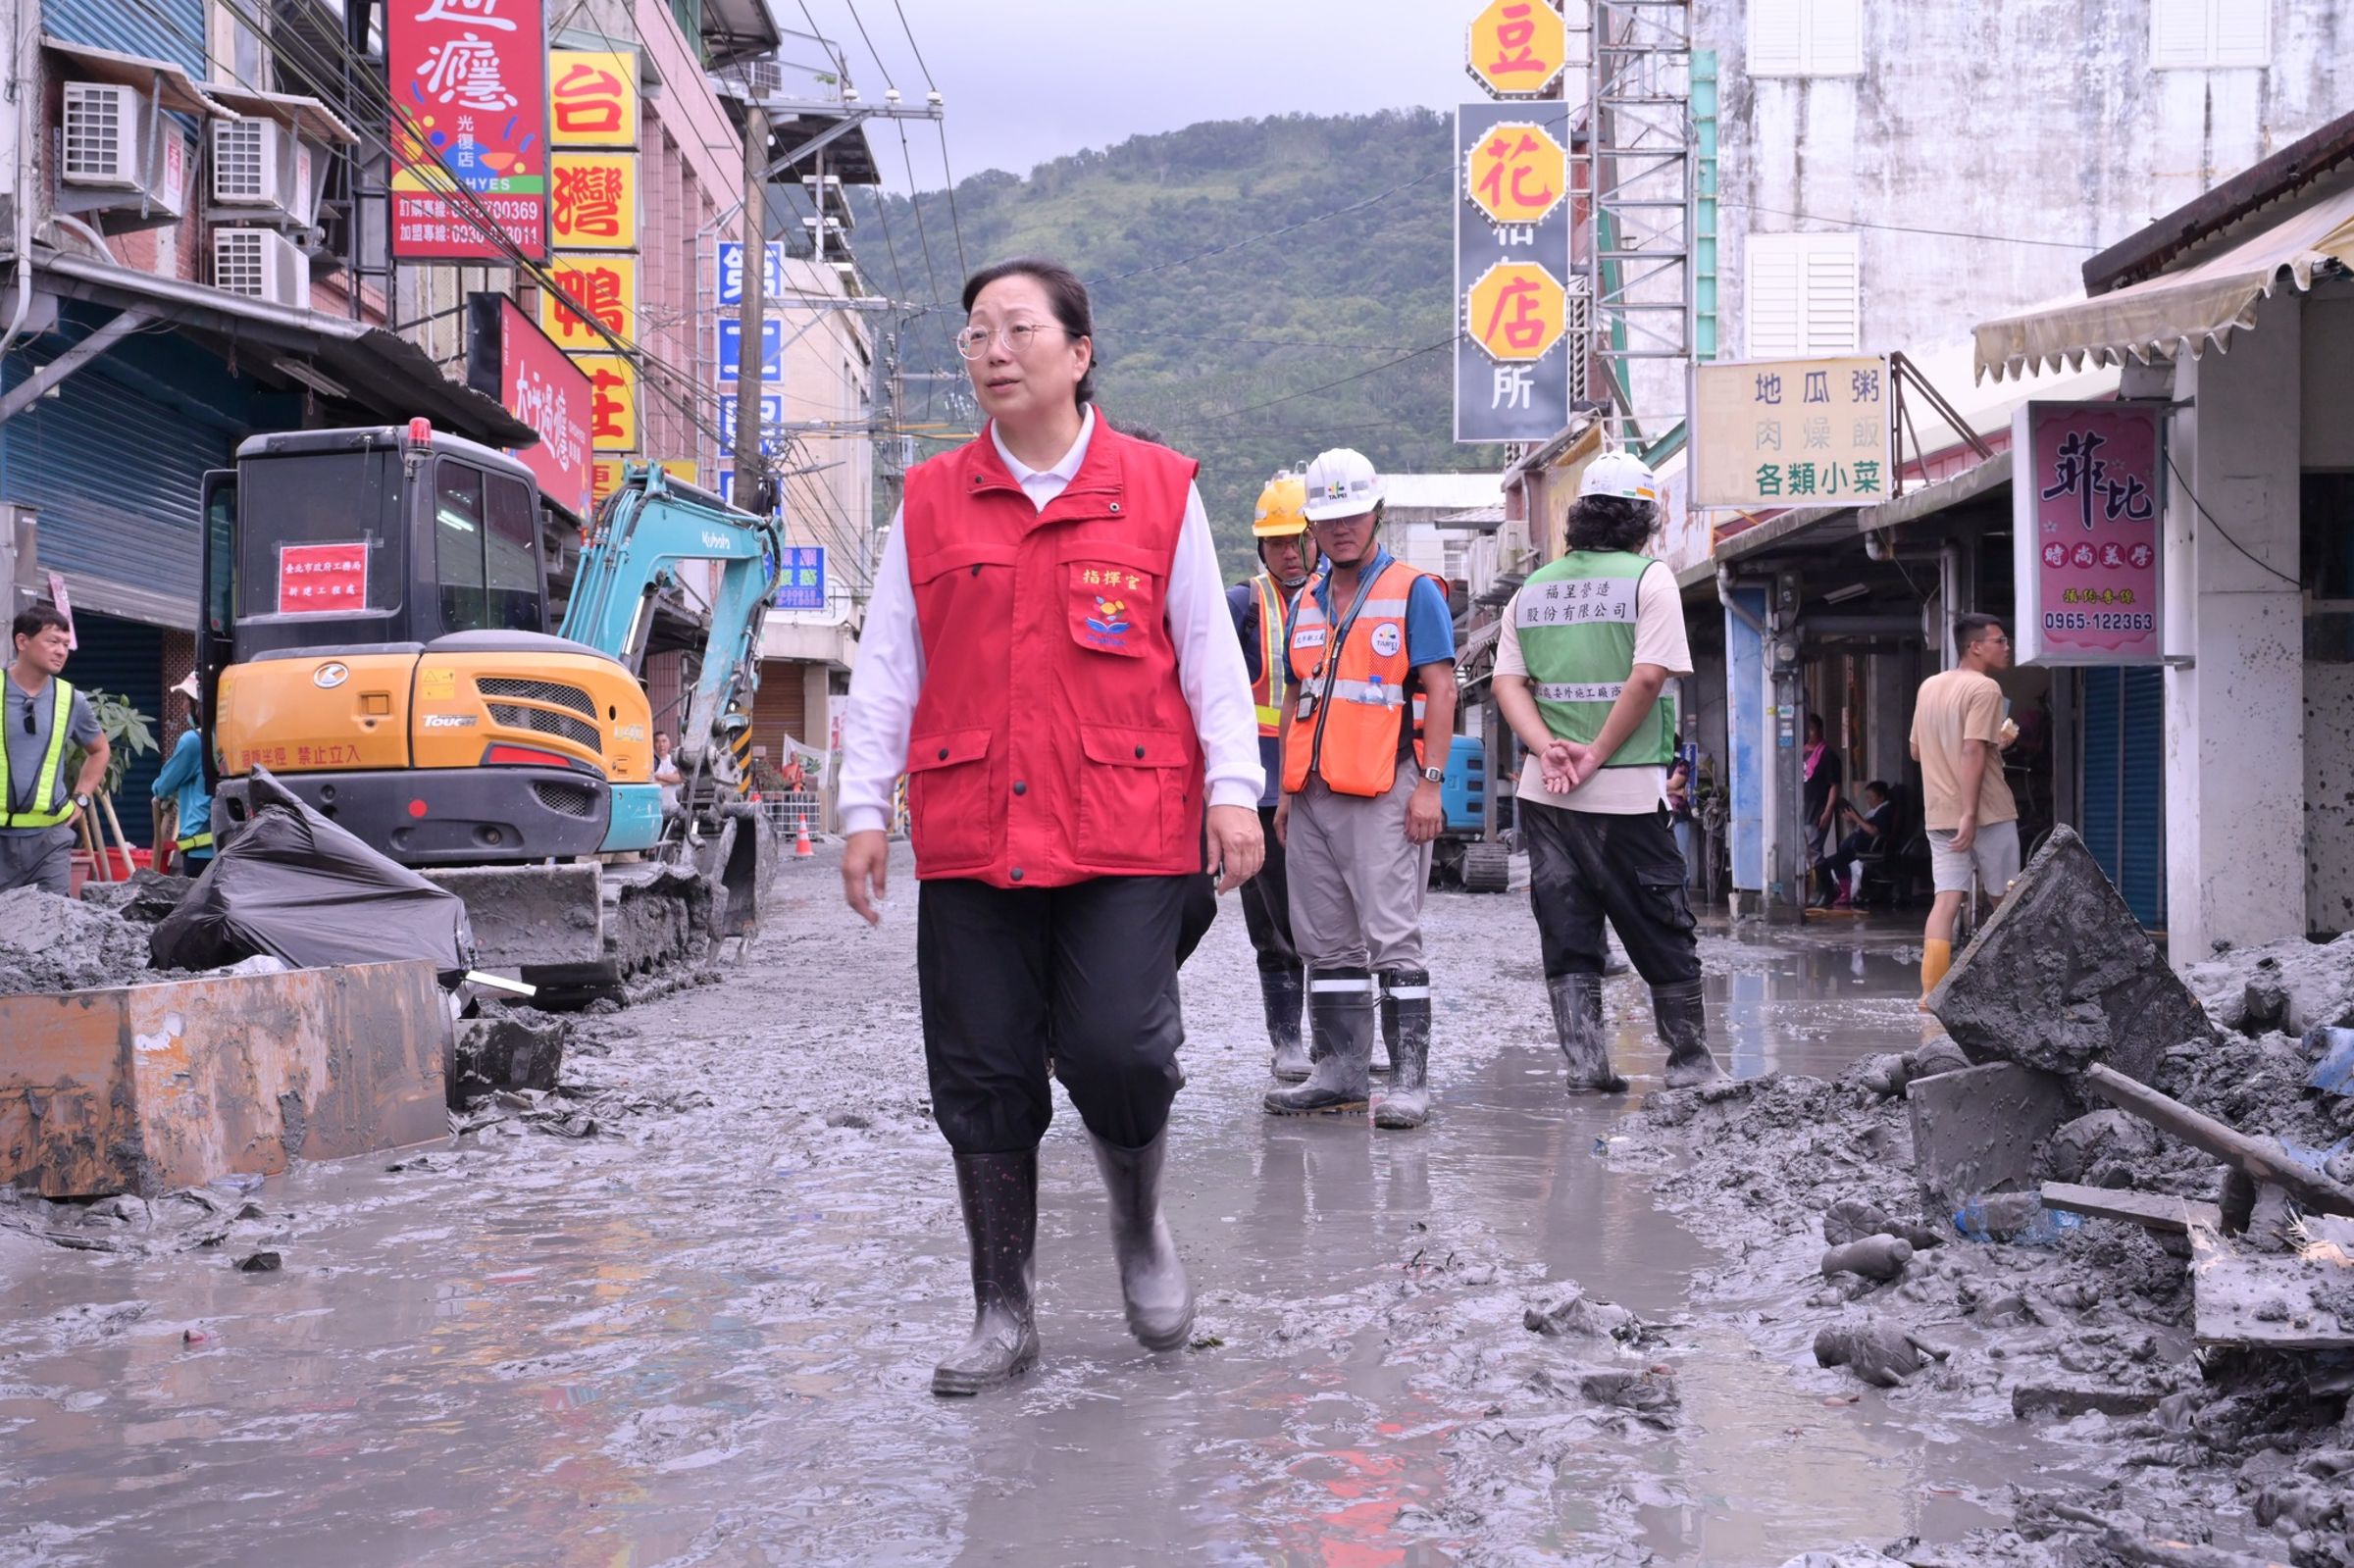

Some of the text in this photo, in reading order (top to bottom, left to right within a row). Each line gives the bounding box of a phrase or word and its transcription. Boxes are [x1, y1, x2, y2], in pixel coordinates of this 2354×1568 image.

[457, 116, 475, 168] 光復店
[1755, 370, 1880, 405] 地瓜粥
[1755, 416, 1880, 452] 肉燥飯
[1756, 460, 1881, 497] 各類小菜
[2042, 430, 2154, 530] 菲比
[2045, 544, 2152, 566] 時尚美學
[1083, 569, 1140, 590] 指揮官
[1526, 602, 1626, 622] 股份有限公司
[2045, 612, 2153, 630] 0965-122363
[297, 744, 361, 765] 禁止立入
